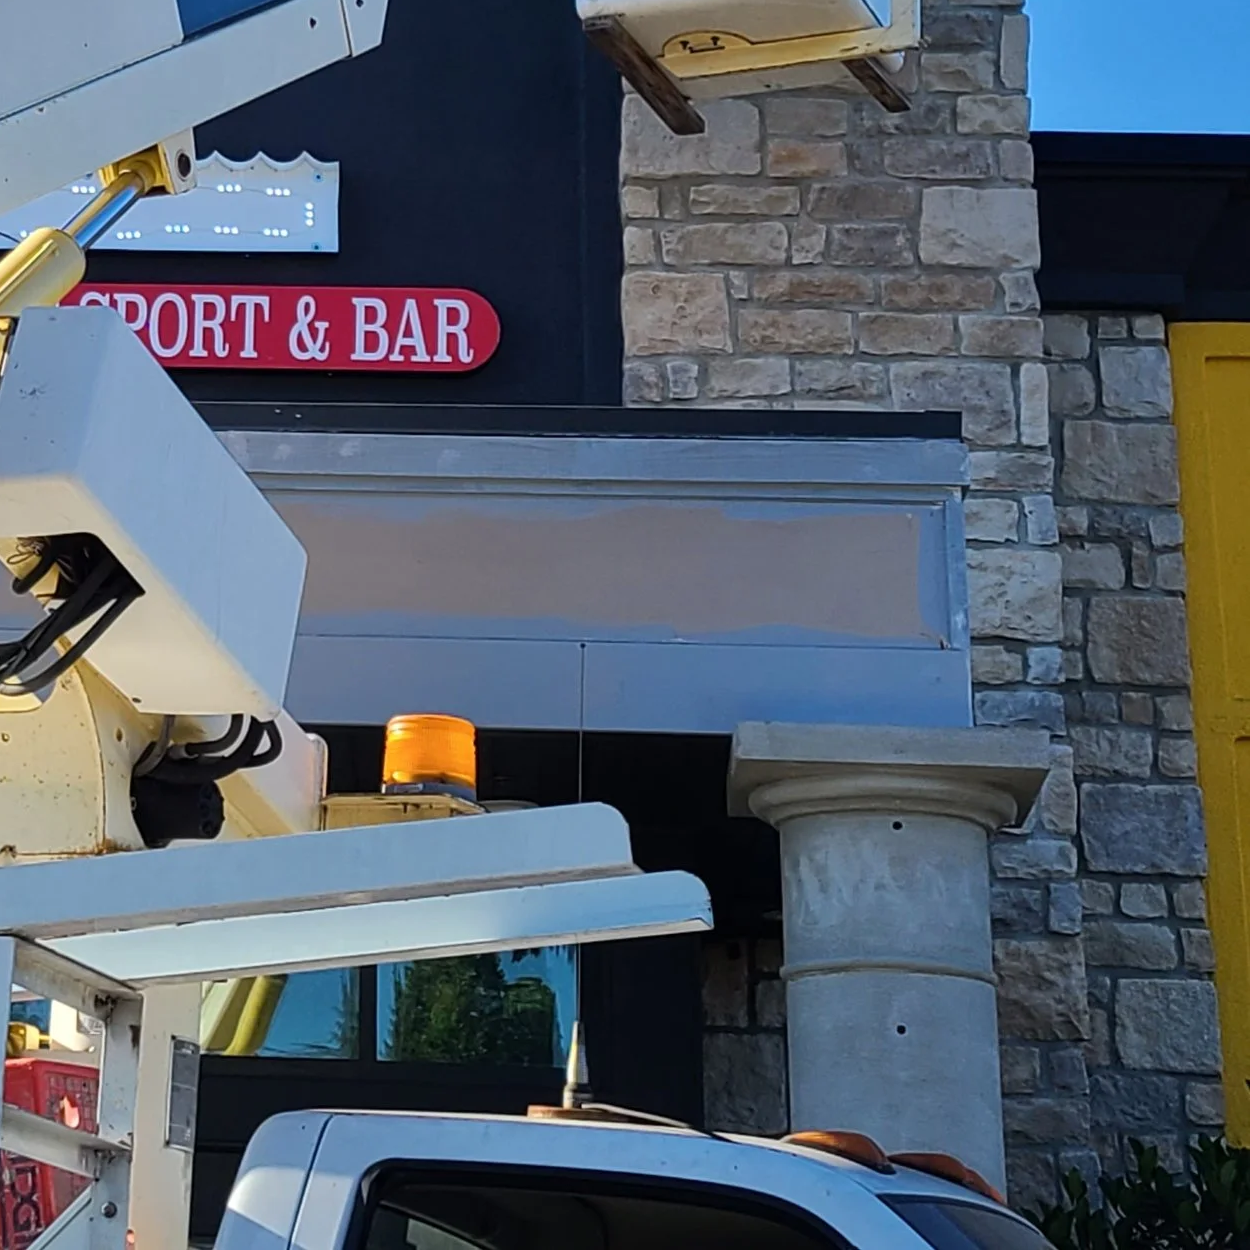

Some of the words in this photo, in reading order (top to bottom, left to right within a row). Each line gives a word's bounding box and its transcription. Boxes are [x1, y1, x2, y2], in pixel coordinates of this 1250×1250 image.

[79, 291, 270, 358] PORT
[289, 295, 330, 361] &
[350, 297, 474, 364] BAR
